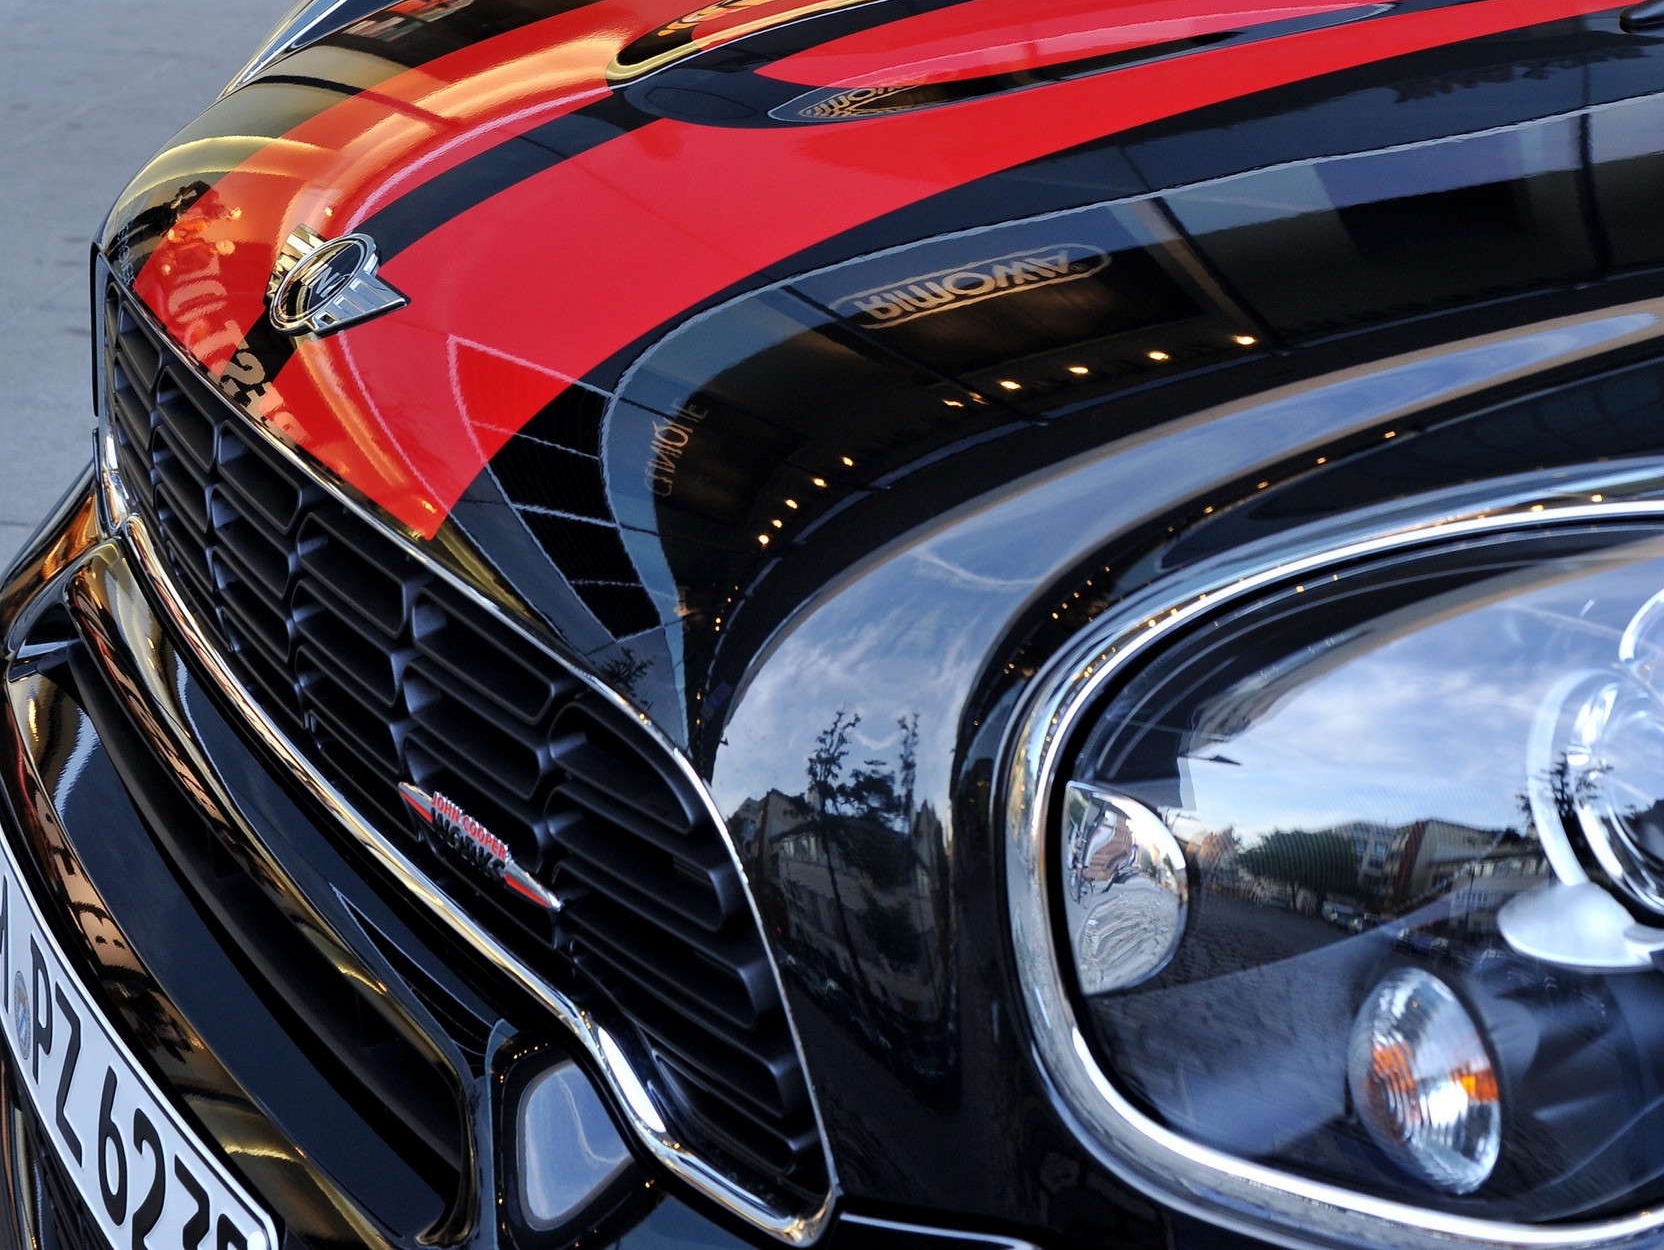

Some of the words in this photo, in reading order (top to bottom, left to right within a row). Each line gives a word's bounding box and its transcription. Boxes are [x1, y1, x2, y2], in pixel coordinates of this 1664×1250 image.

[432, 792, 462, 824] JOHN
[462, 816, 509, 862] COOPER
[30, 933, 83, 1169] PZ
[98, 1065, 249, 1250] 627
